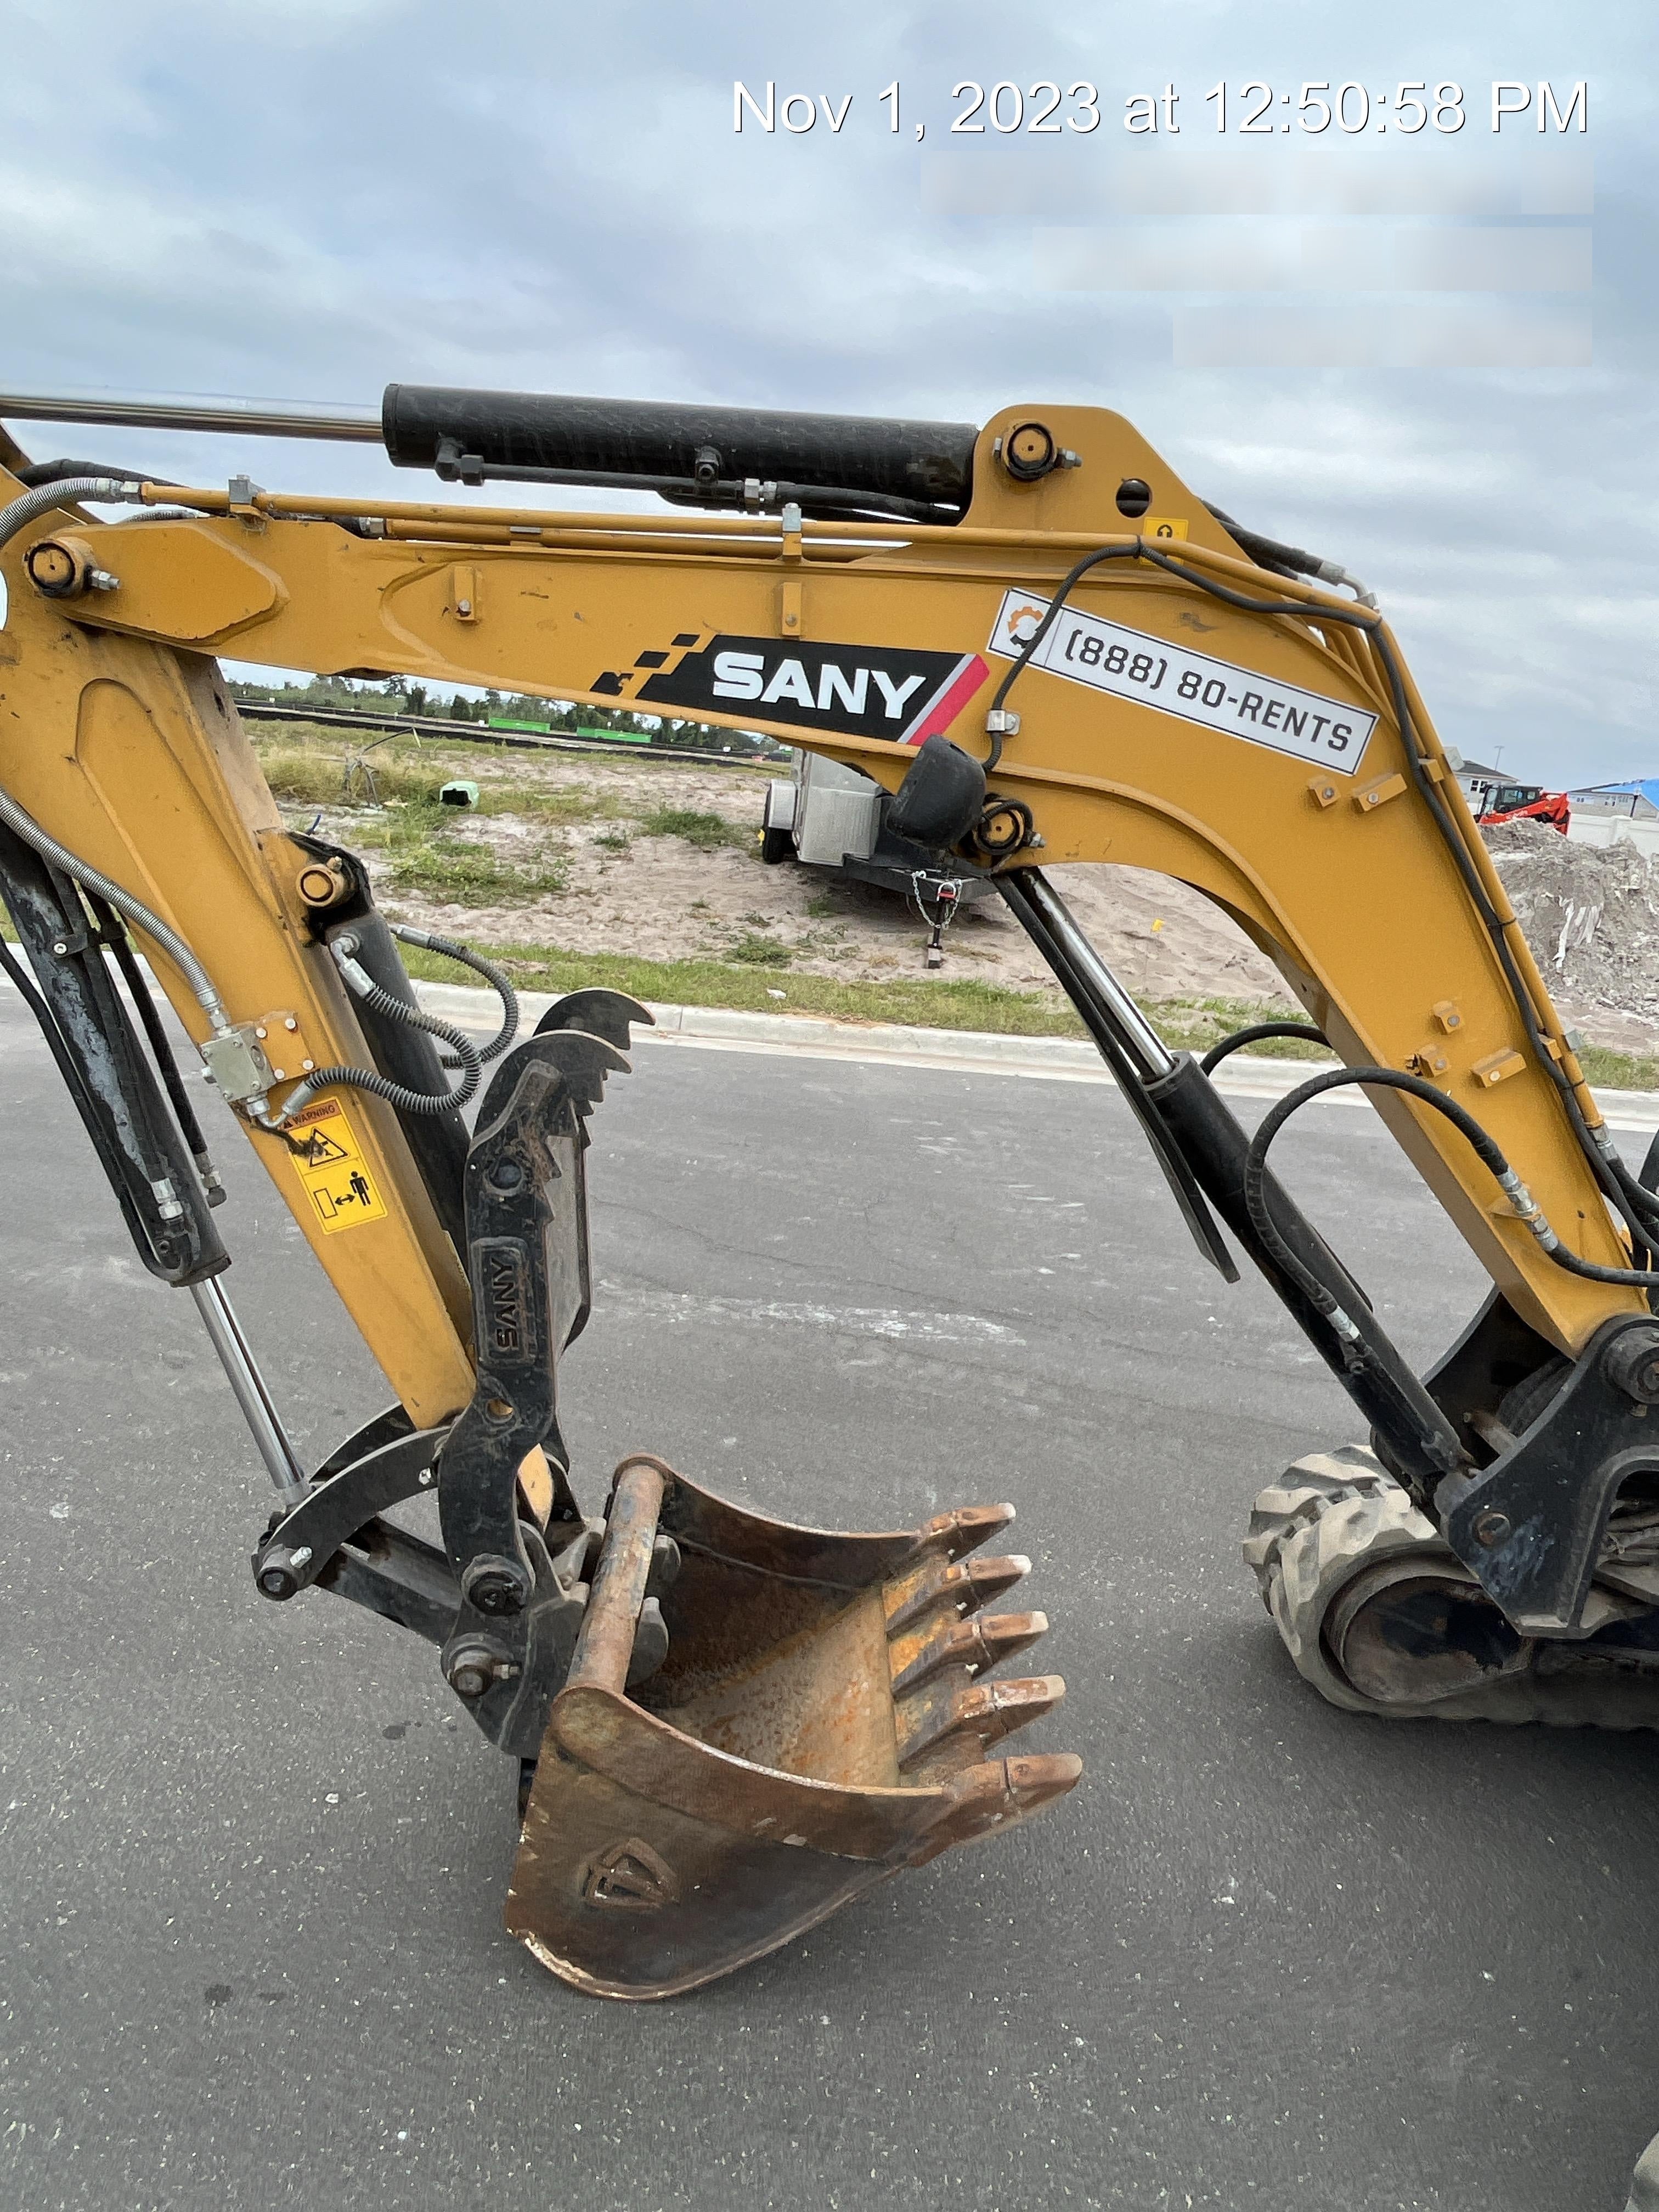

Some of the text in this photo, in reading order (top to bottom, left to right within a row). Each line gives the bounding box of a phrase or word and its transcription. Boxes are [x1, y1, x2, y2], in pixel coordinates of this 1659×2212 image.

[712, 651, 927, 720] SANY
[1065, 629, 1352, 752] (888) 80-RENTS
[292, 1105, 335, 1125] WARNING
[491, 1257, 518, 1350] SANY
